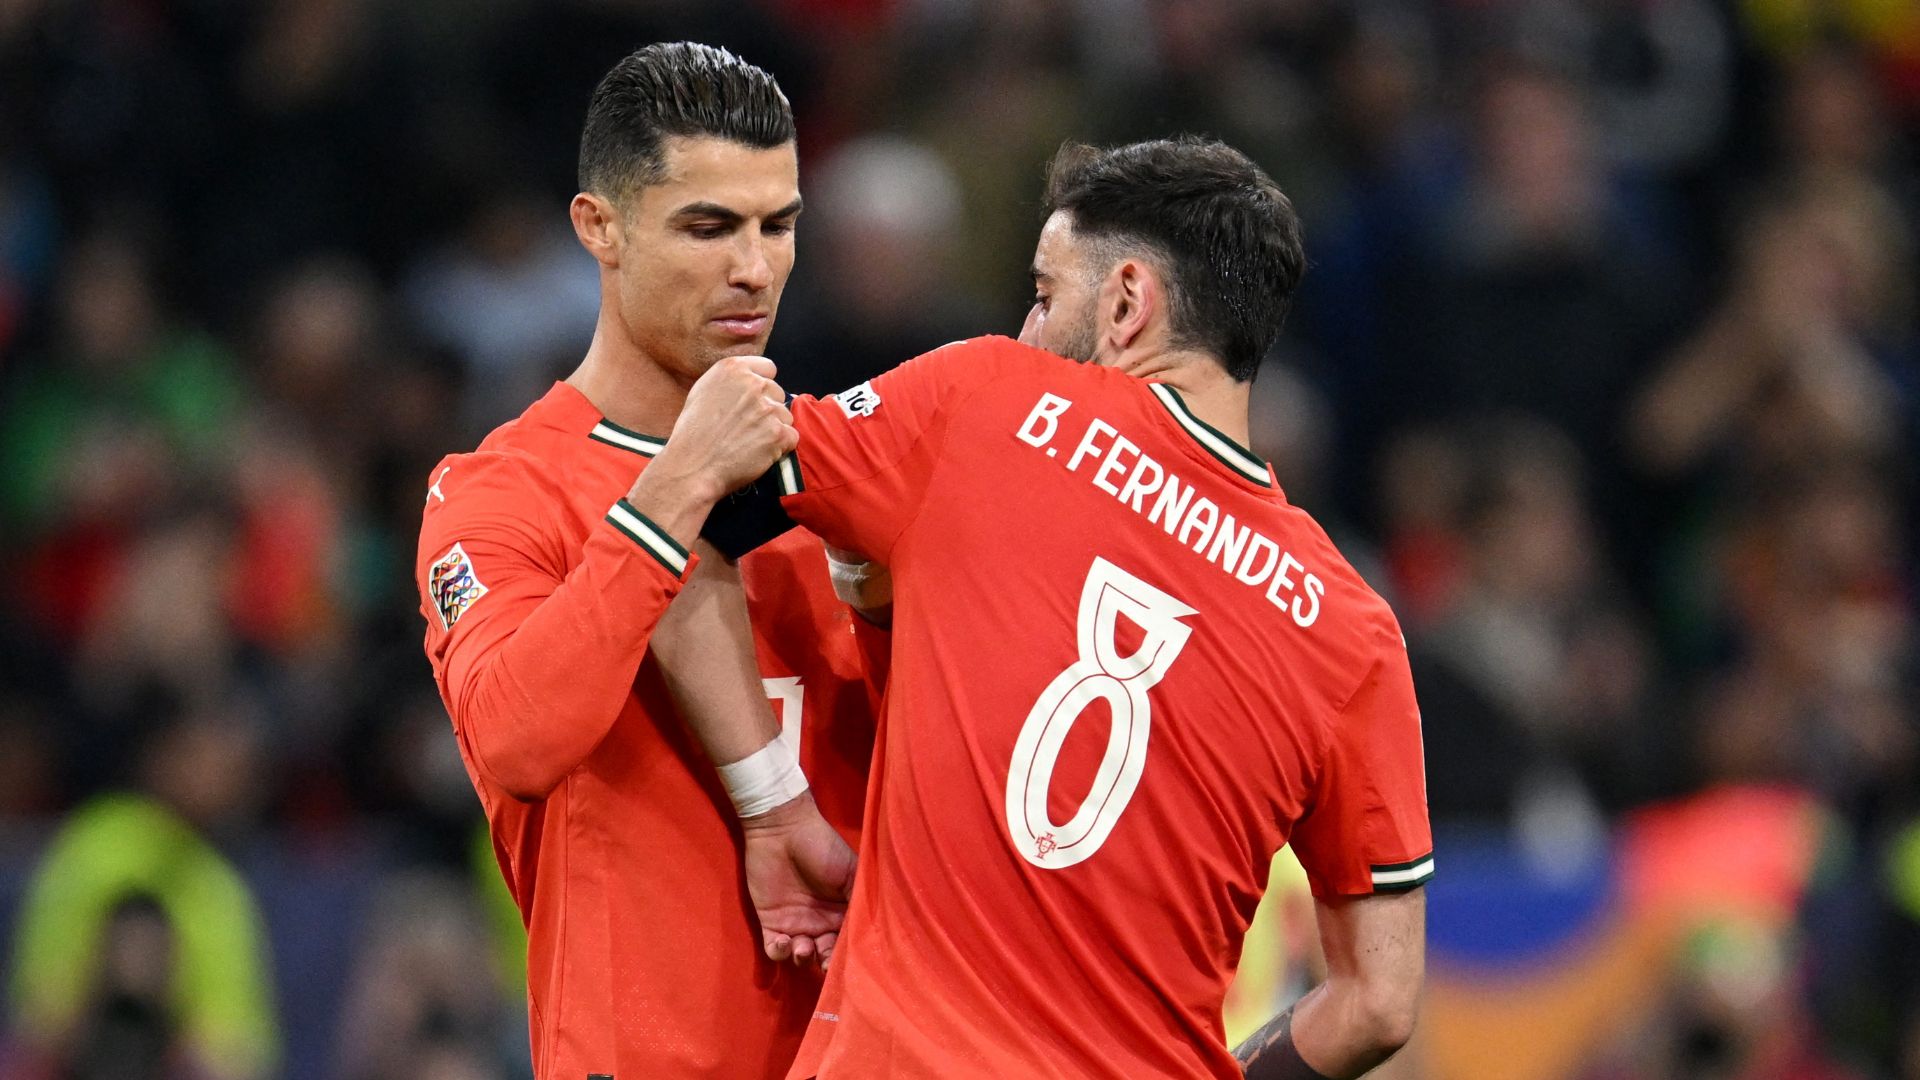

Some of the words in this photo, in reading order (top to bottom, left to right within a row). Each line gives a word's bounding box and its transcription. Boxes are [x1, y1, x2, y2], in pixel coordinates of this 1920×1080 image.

[1016, 391, 1073, 458] B.
[1066, 418, 1325, 628] FERNANDES
[1005, 555, 1201, 870] 8
